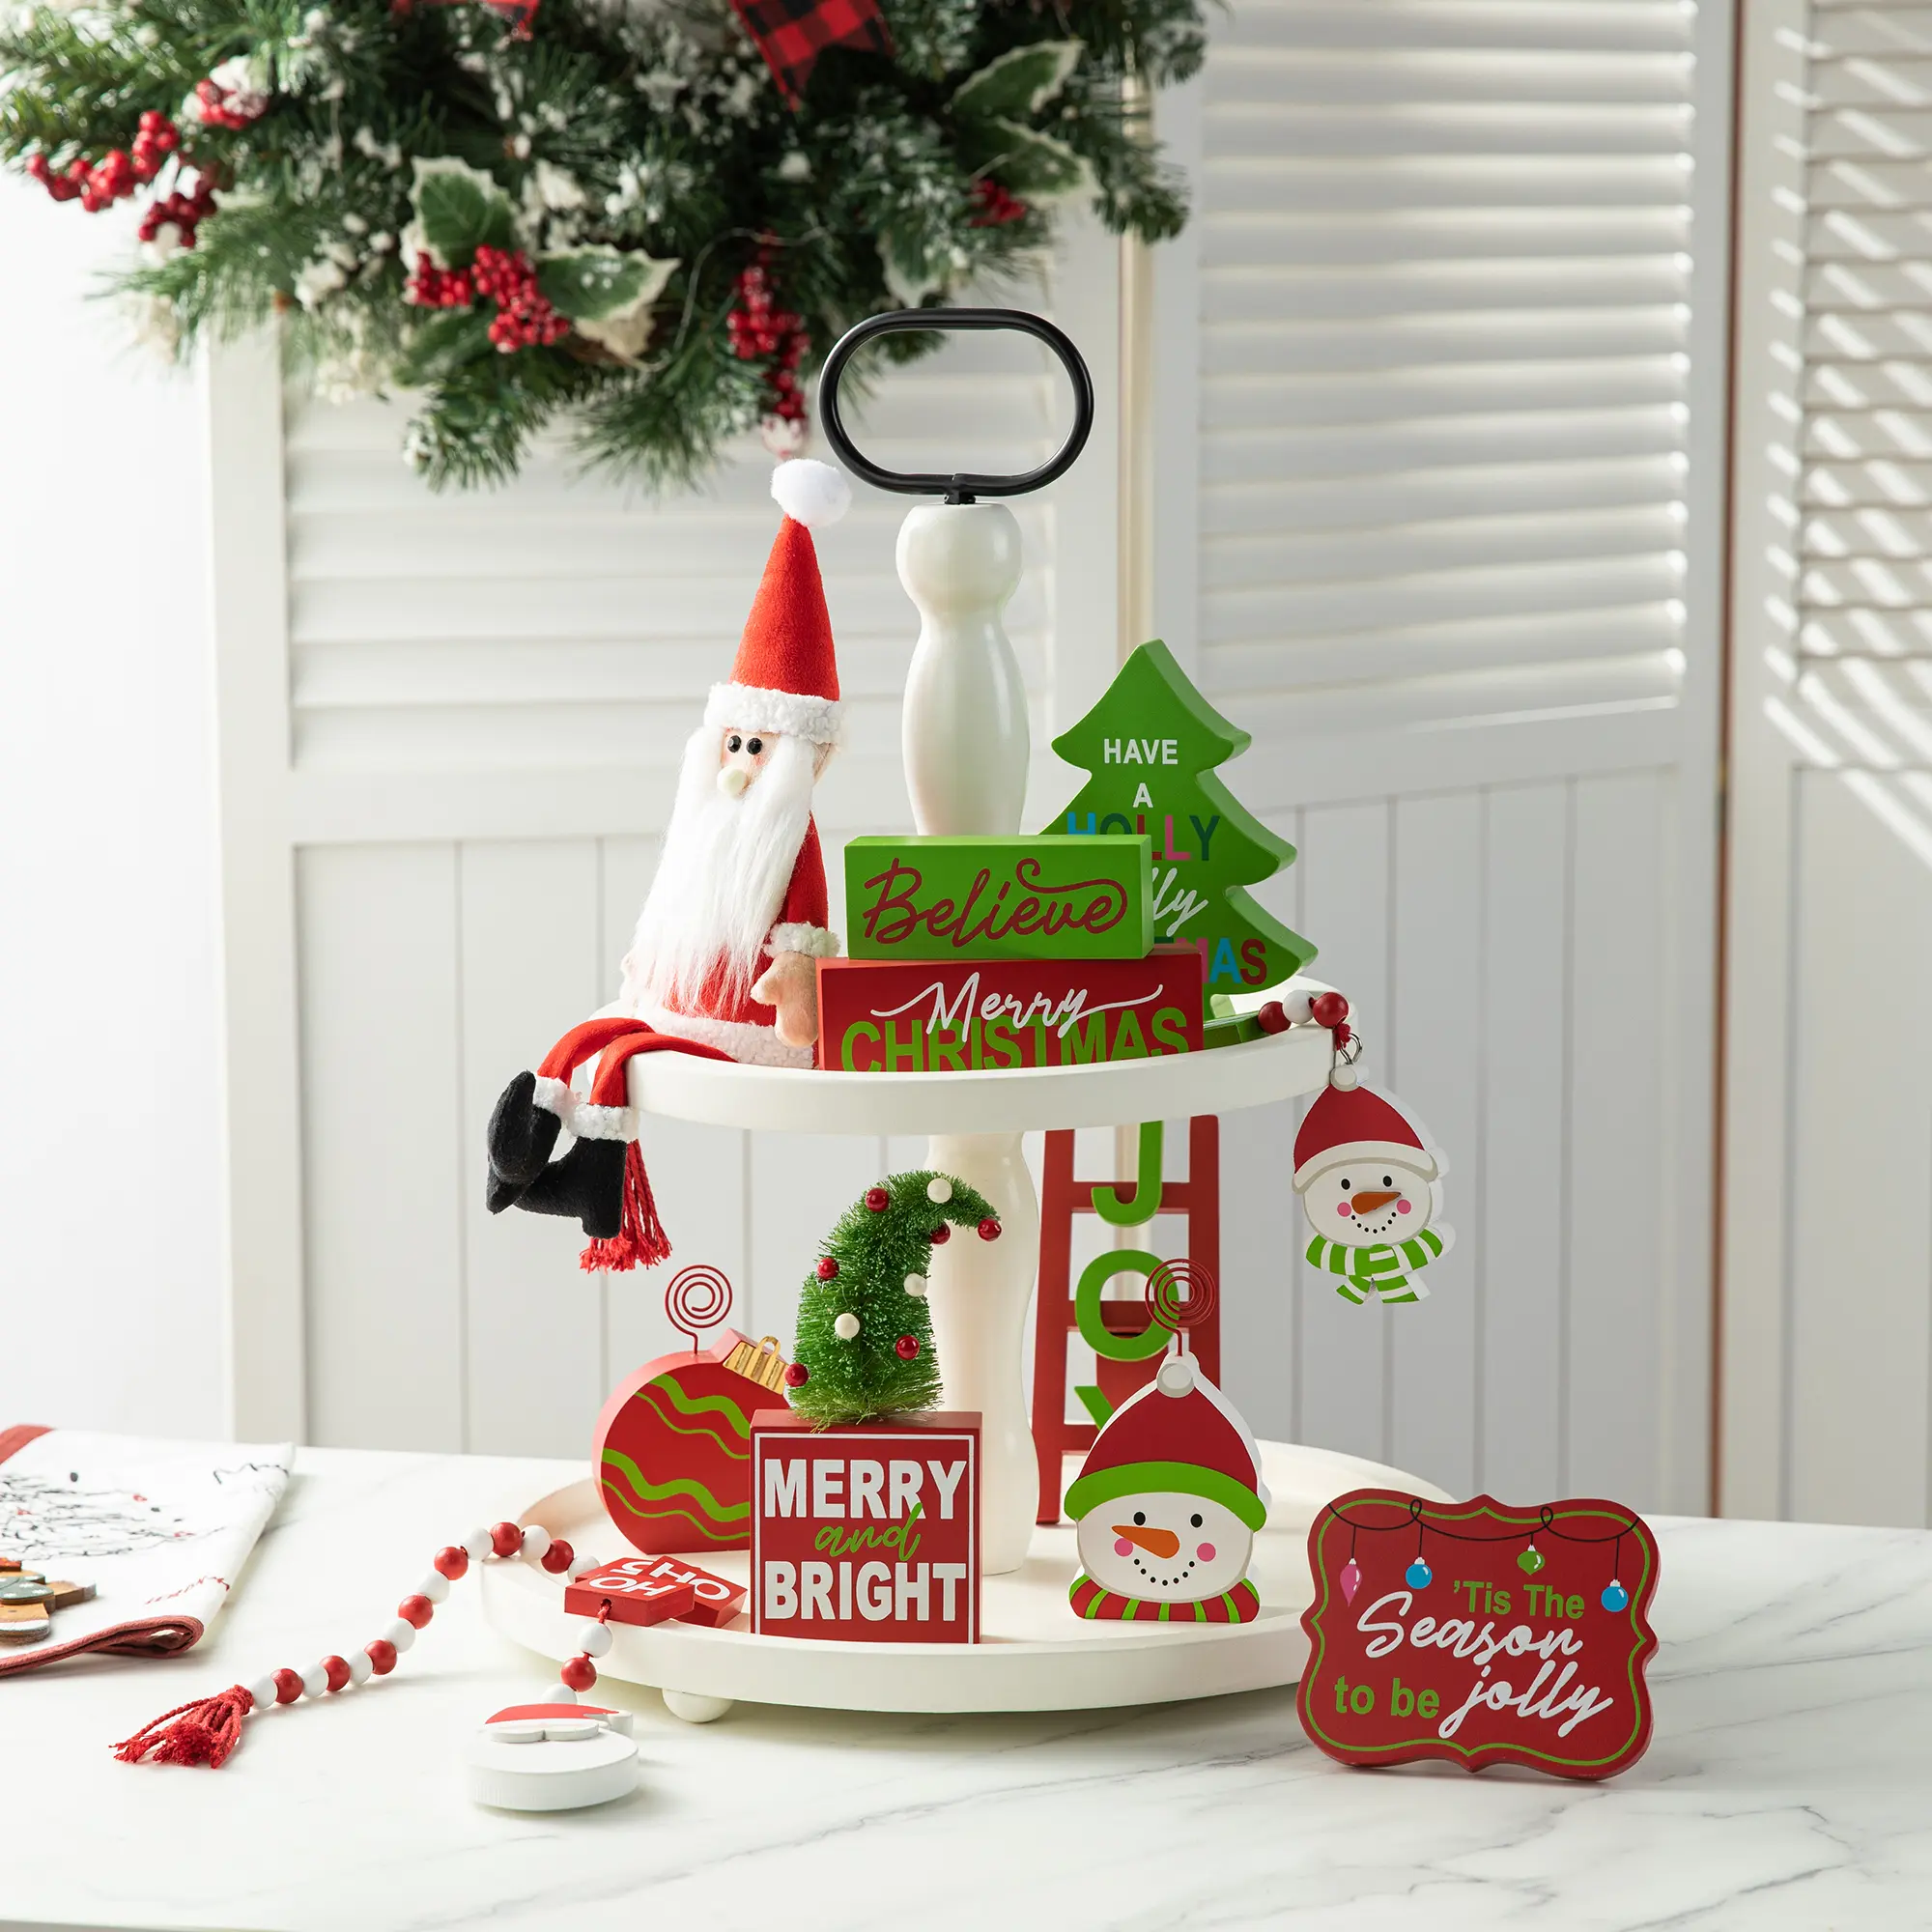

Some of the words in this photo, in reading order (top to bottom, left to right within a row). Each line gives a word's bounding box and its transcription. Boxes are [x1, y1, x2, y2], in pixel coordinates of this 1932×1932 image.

[1104, 738, 1179, 765] HAVE
[1132, 782, 1153, 808] A
[864, 857, 1128, 948] Believe
[870, 972, 1163, 1042] Merry
[840, 1007, 1189, 1072] CHRISTMAS
[1074, 1121, 1180, 1431] JO
[764, 1459, 967, 1520] MERRY
[814, 1502, 923, 1561] and
[649, 1561, 730, 1600] HO
[764, 1560, 966, 1622] BRIGHT
[1523, 1584, 1584, 1619] The
[1356, 1591, 1583, 1665] Season
[1334, 1675, 1375, 1715] to
[1391, 1677, 1439, 1719] be
[1438, 1660, 1613, 1738] jolly
